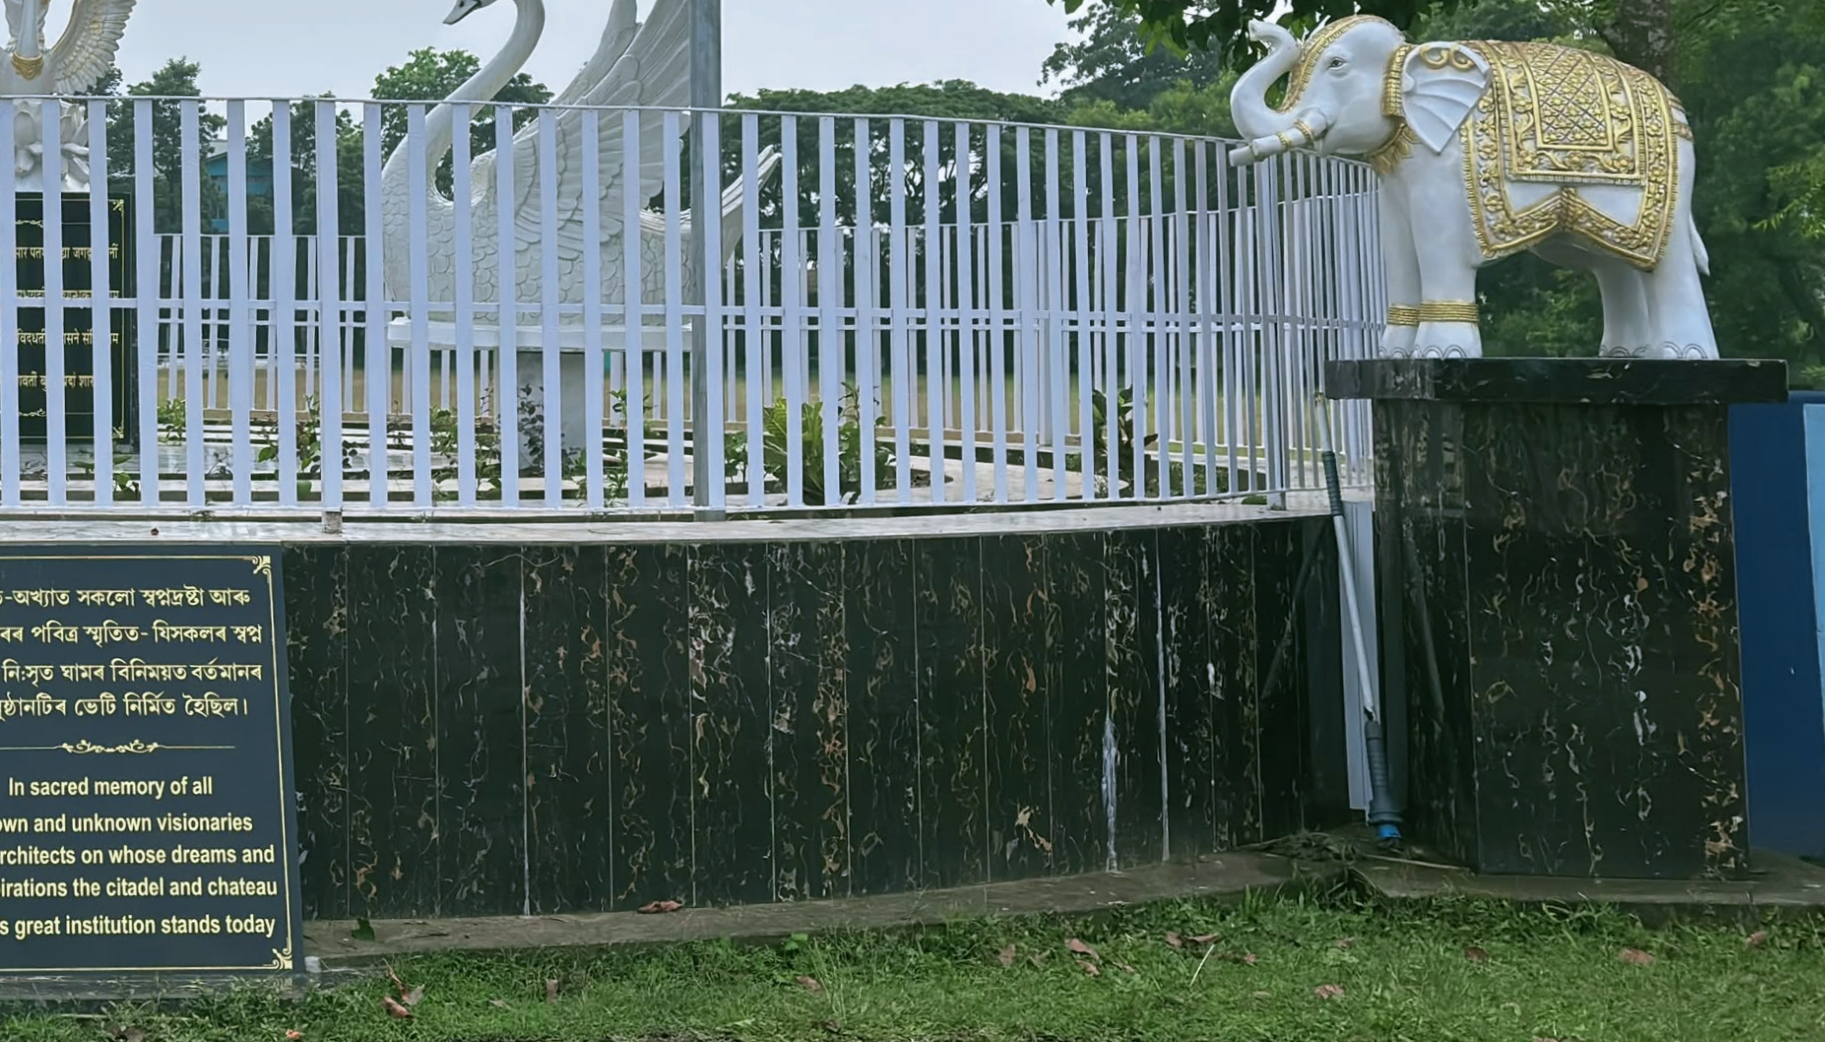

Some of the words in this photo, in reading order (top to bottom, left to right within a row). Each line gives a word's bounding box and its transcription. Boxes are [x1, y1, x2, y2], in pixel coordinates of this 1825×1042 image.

[76, 588, 135, 607] সকলো
[208, 588, 251, 606] আৰু
[151, 619, 227, 643] যিসকলৰ
[230, 623, 263, 644] স্বপ্ন
[60, 663, 105, 682] ঘামৰ
[74, 691, 117, 716] ভেটি
[122, 691, 176, 716] নিৰ্মিত
[9, 777, 25, 796] In
[30, 776, 89, 796] sacred
[94, 780, 165, 800] memory
[169, 775, 189, 795] of
[192, 775, 213, 795] all
[33, 813, 66, 833] and
[71, 812, 152, 832] unknown
[156, 812, 253, 832] visionaries
[80, 849, 104, 864] on
[108, 844, 167, 864] whose
[171, 844, 237, 864] dreams
[242, 844, 275, 864] and
[72, 877, 101, 897] the
[105, 876, 164, 897] citadel
[169, 876, 203, 896] and
[207, 876, 278, 896] chateau
[14, 916, 61, 940] great
[65, 914, 156, 935] institution
[160, 914, 221, 934] stands
[225, 913, 276, 938] today
